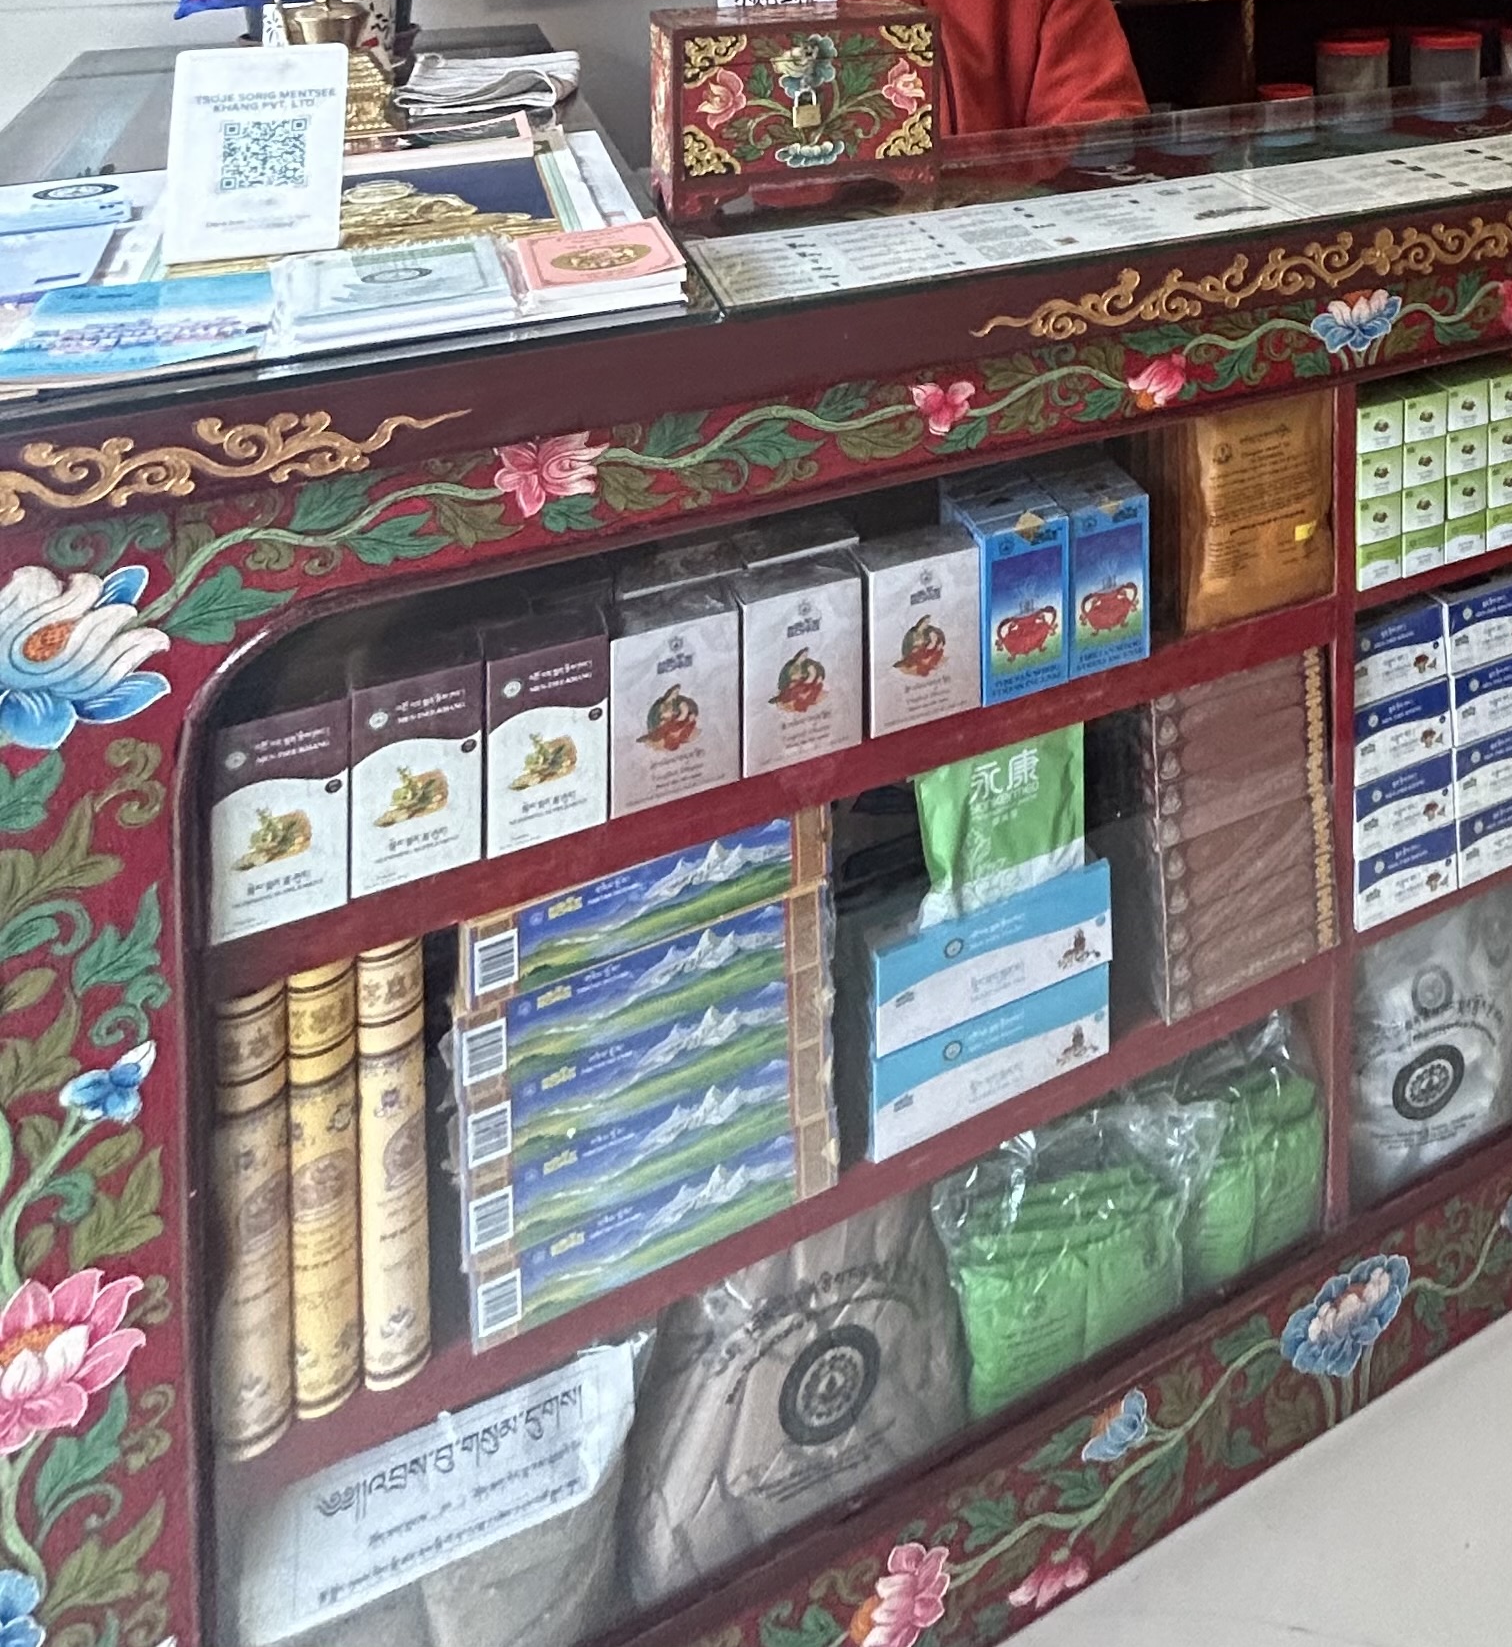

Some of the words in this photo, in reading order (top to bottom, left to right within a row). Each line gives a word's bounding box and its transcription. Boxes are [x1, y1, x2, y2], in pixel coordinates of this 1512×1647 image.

[238, 91, 277, 102] SORIG
[212, 101, 259, 113] KHANG
[969, 748, 1040, 805] 永康
